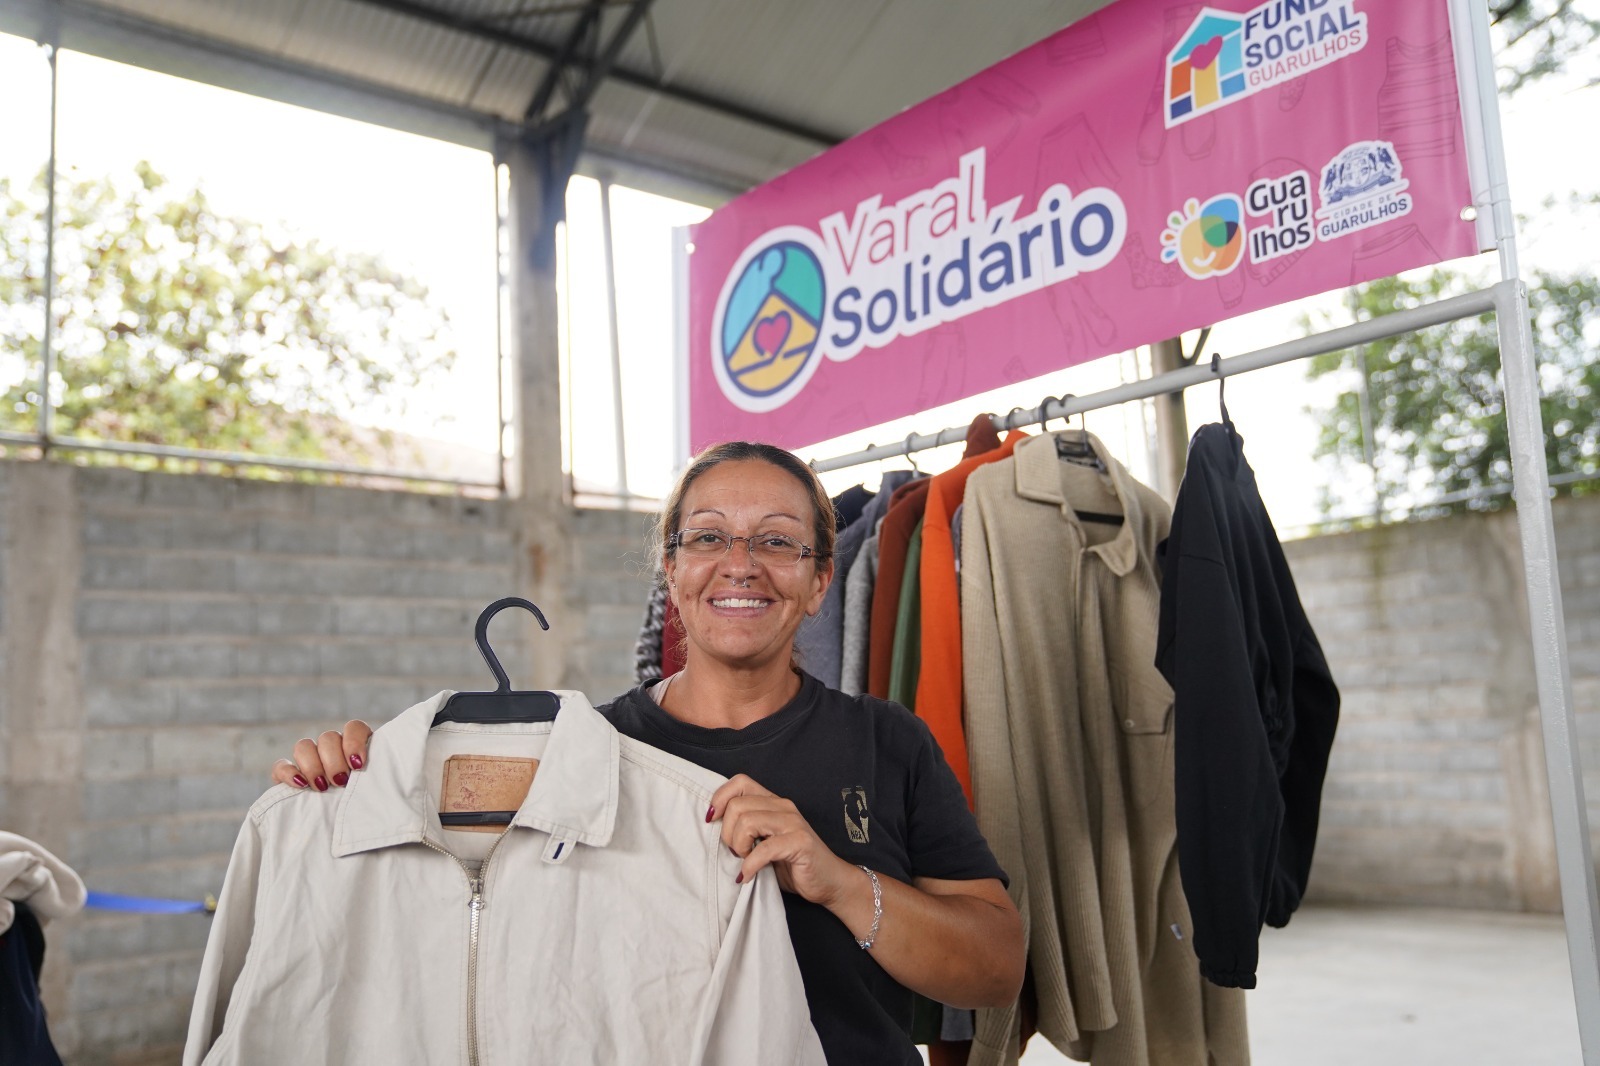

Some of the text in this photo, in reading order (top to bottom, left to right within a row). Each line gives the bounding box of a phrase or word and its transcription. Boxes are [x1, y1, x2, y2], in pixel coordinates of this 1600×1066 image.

[1245, 5, 1360, 68] SOCIAL
[1249, 29, 1361, 86] GUARULHOS
[1250, 175, 1306, 212] Gua
[1278, 198, 1308, 227] ru
[1321, 198, 1408, 236] GUARULHOS
[1333, 193, 1392, 219] CIDADE DE
[832, 164, 976, 277] Varal
[831, 198, 1114, 348] Solidário
